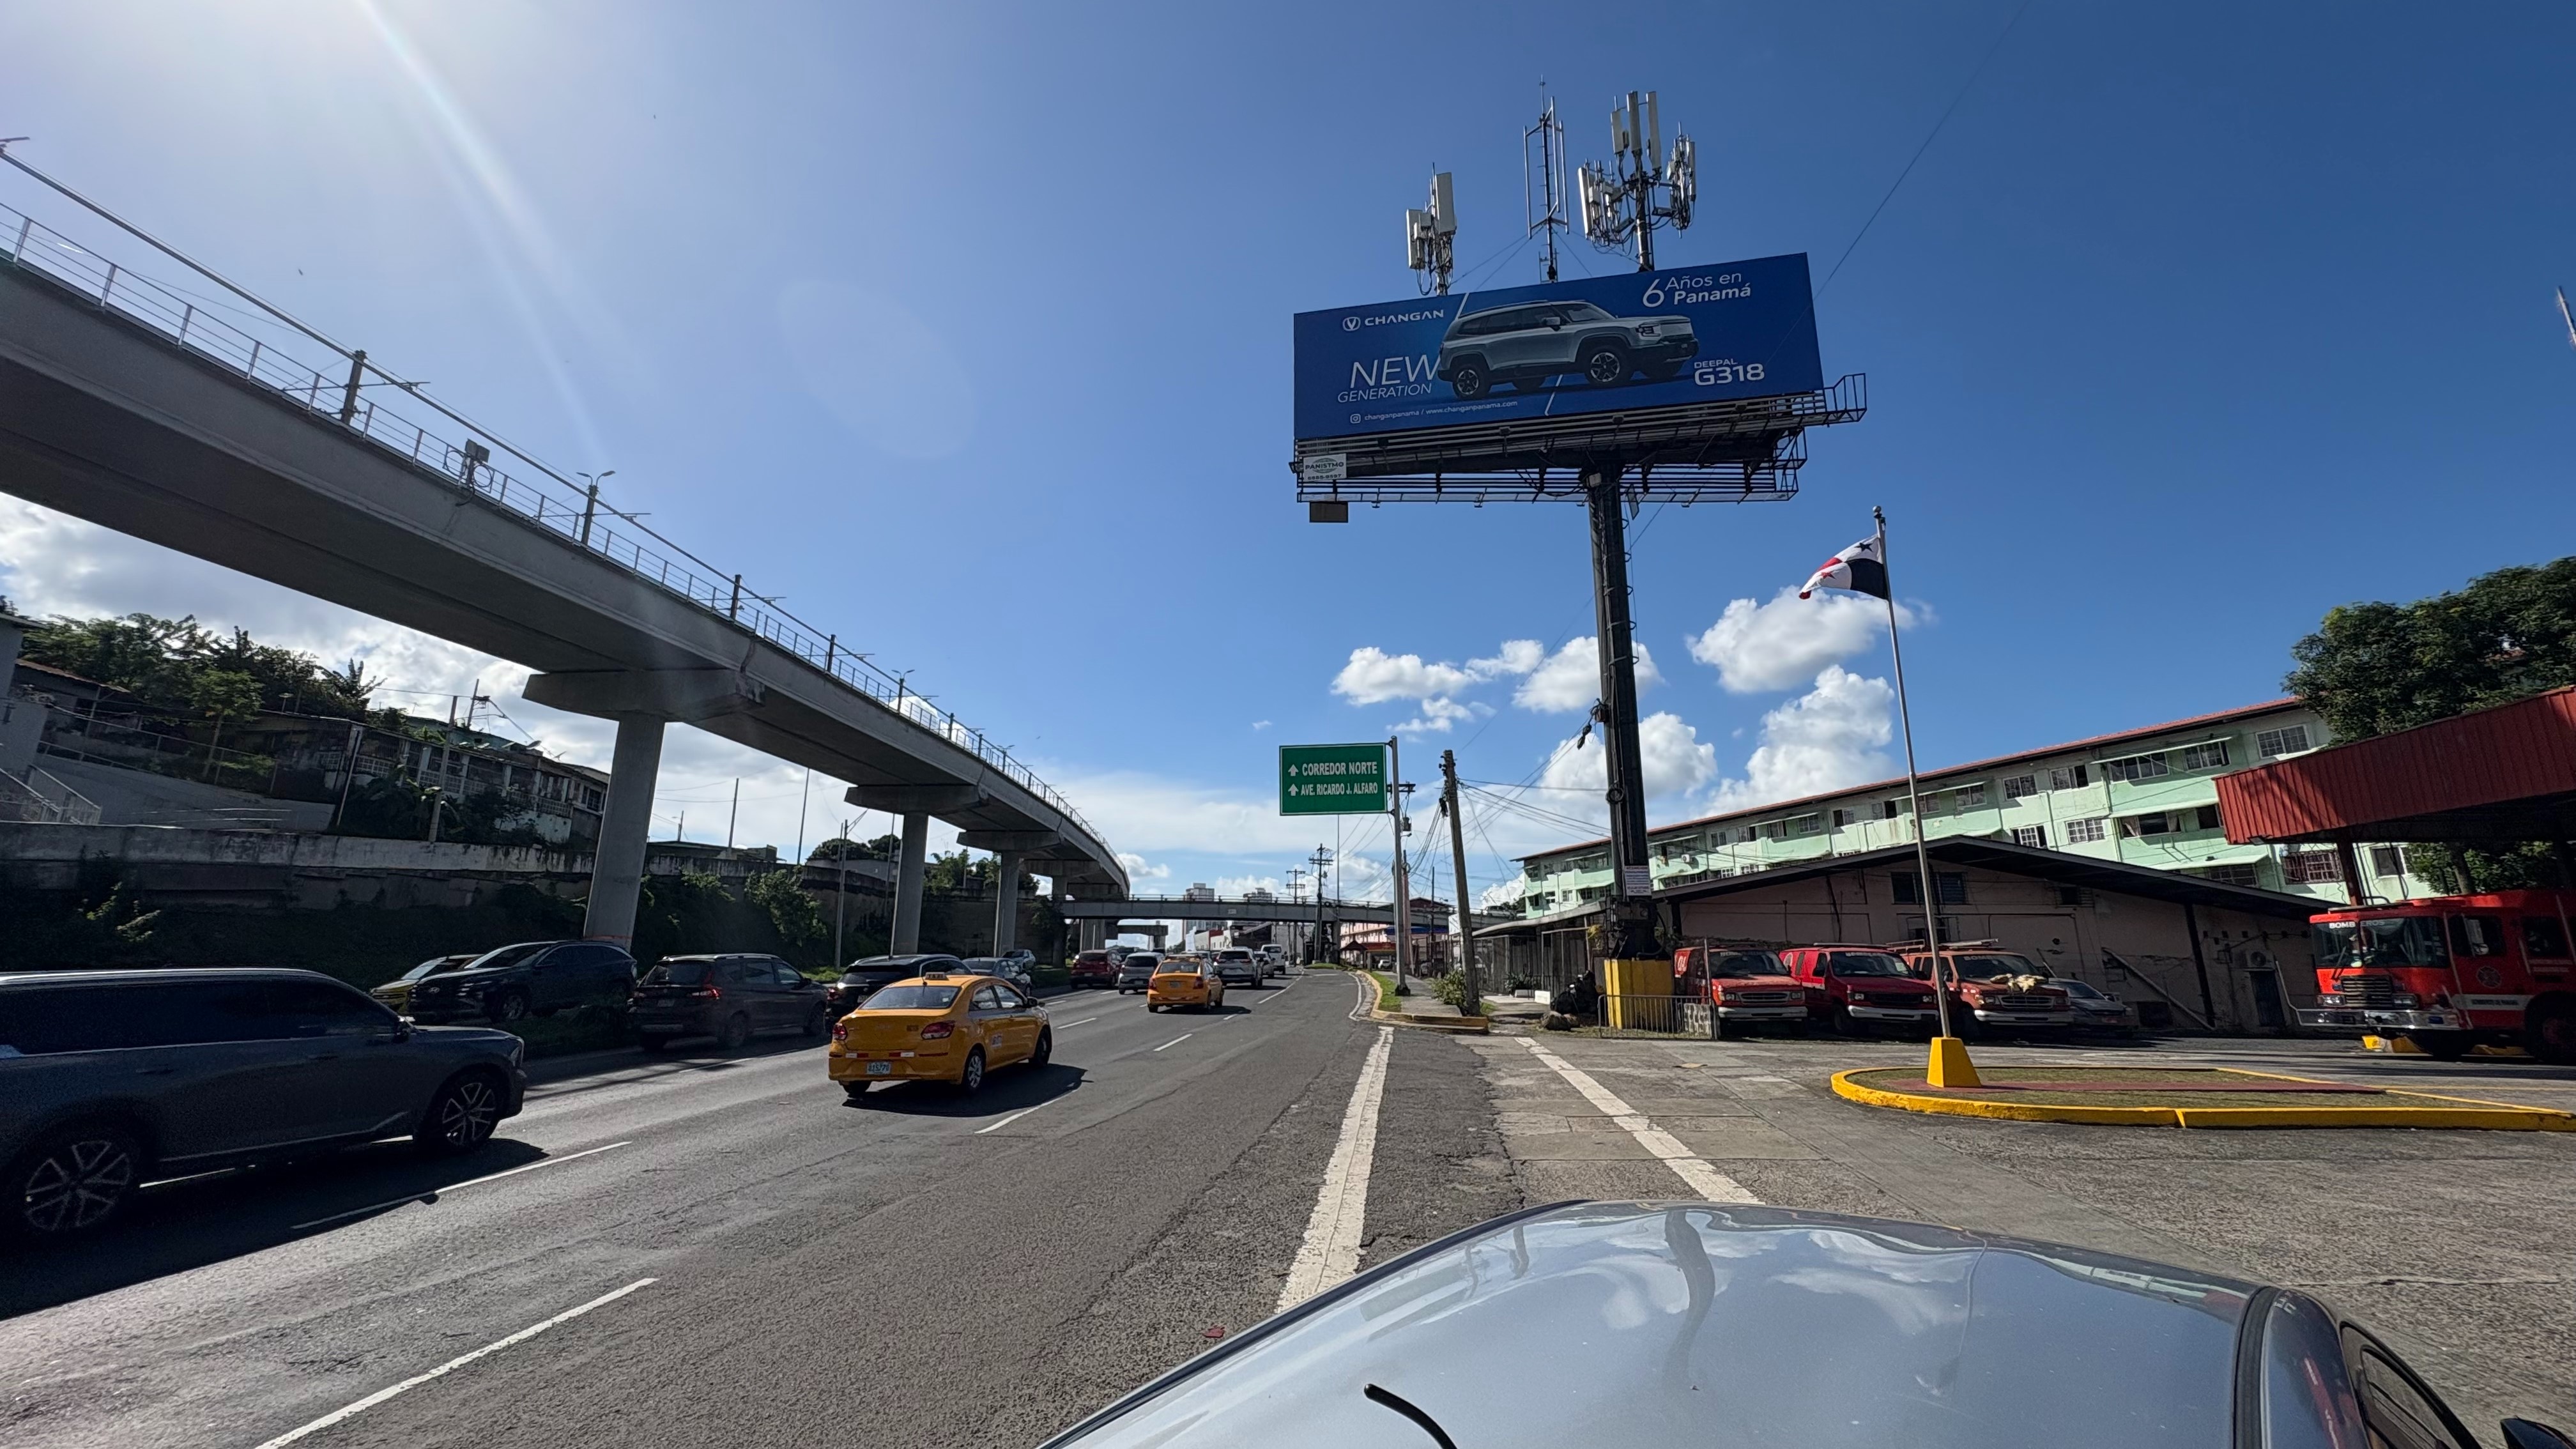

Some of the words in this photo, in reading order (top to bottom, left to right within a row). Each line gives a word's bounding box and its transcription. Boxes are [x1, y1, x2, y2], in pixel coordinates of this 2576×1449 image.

[1643, 279, 1664, 308] 6
[1664, 275, 1713, 291] Años
[1719, 273, 1742, 285] en
[1674, 282, 1751, 305] Panamá
[1365, 309, 1444, 326] CHANGAN
[1350, 354, 1441, 389] NEW
[1694, 358, 1738, 369] DEEPAL
[1695, 364, 1765, 386] G318
[1337, 383, 1432, 403] GENERATION
[1364, 410, 1420, 421] changanpanama
[1426, 400, 1518, 415] www.changanpanama.com
[1305, 462, 1344, 470] PANISTMO
[1302, 762, 1347, 776] CORREDOR
[1349, 762, 1378, 775] NORTE
[1301, 784, 1315, 796] AVE.
[1317, 783, 1345, 795] RICARDO
[1346, 783, 1353, 795] J.
[1353, 782, 1378, 794] ALFARO
